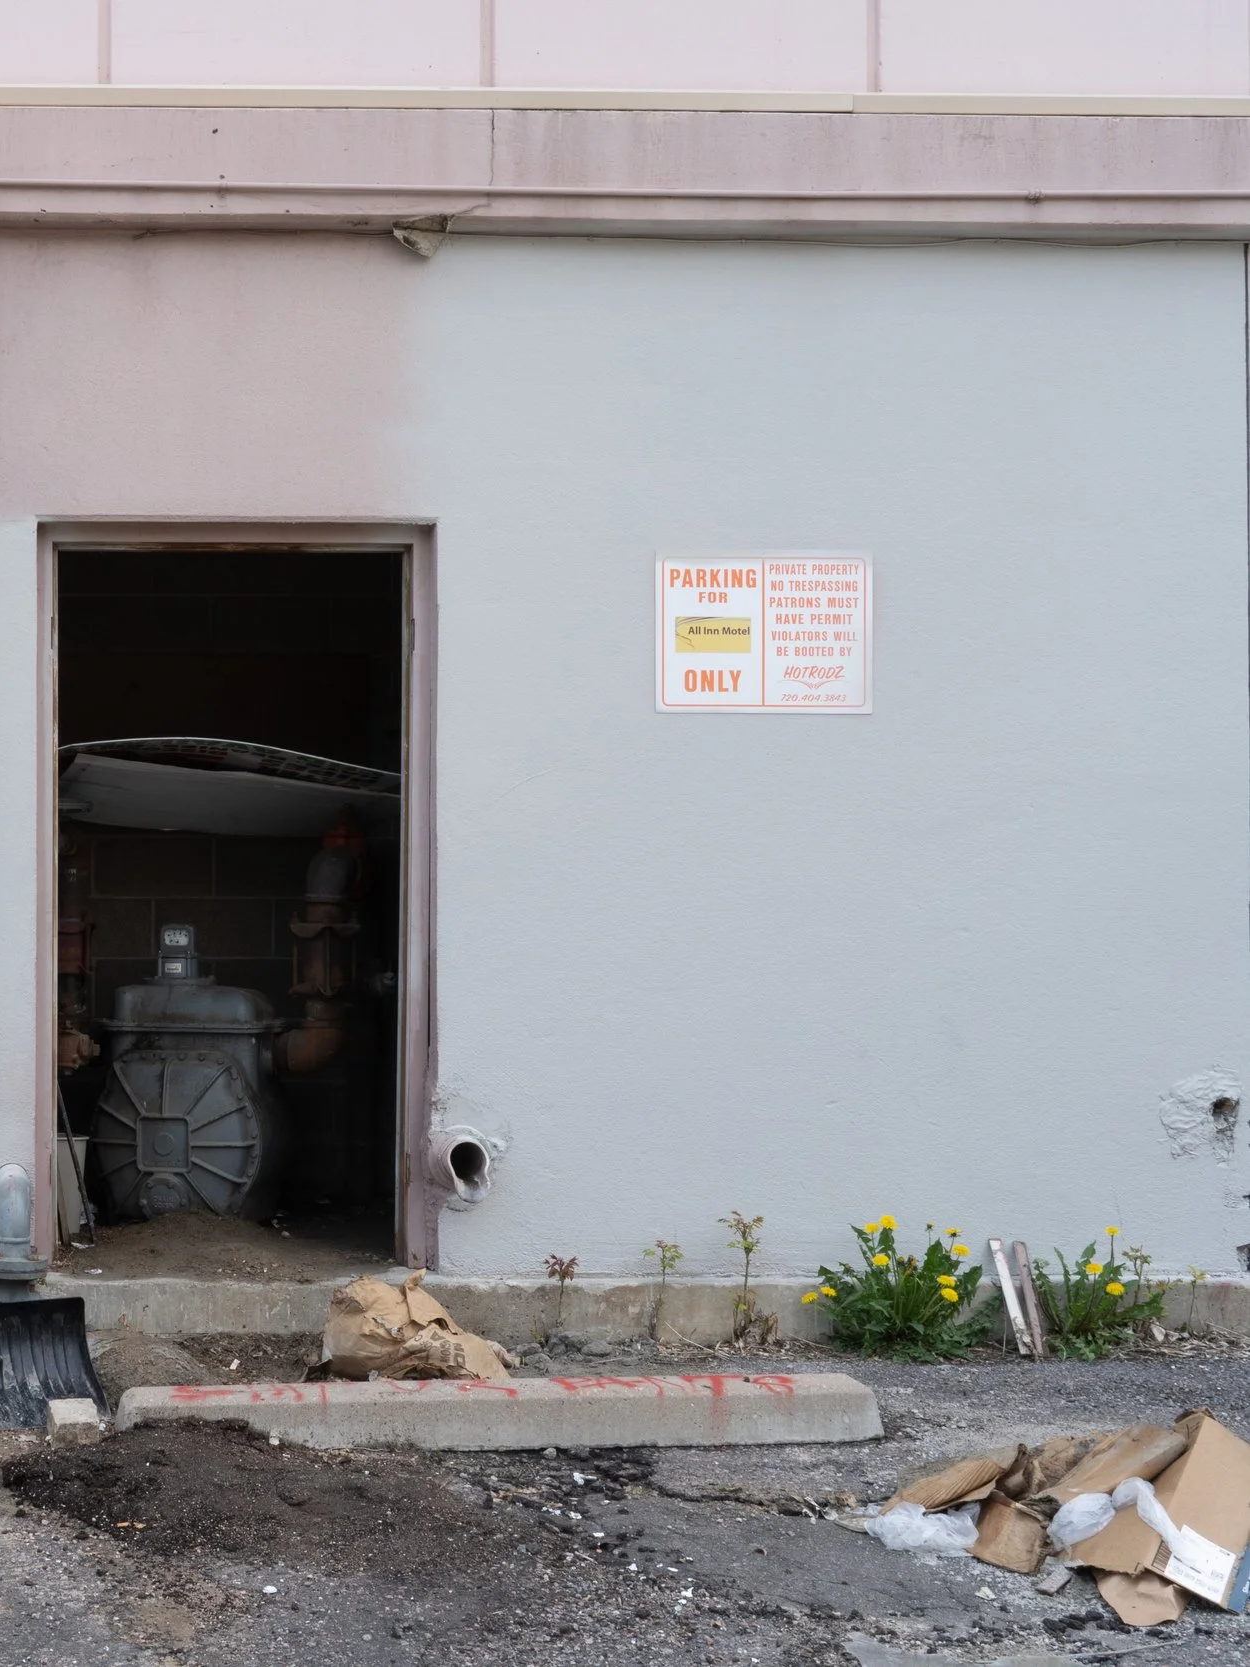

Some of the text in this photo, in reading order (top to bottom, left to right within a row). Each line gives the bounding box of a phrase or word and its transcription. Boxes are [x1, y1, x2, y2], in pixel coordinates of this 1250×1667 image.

[769, 563, 859, 576] PRIVATE PROPERTY
[669, 568, 757, 589] PARKING
[770, 580, 858, 592] NO TRESPASSING
[698, 592, 728, 604] FOR
[769, 596, 859, 609] PATRONS MUST
[775, 613, 853, 625] HAVE PERMIT
[688, 626, 750, 636] All Inn Motel
[771, 630, 858, 642] VIOLATORS WILL
[776, 646, 852, 657] BE BOOTED BY
[783, 665, 845, 680] HOTRODZ
[684, 668, 742, 693] ONLY
